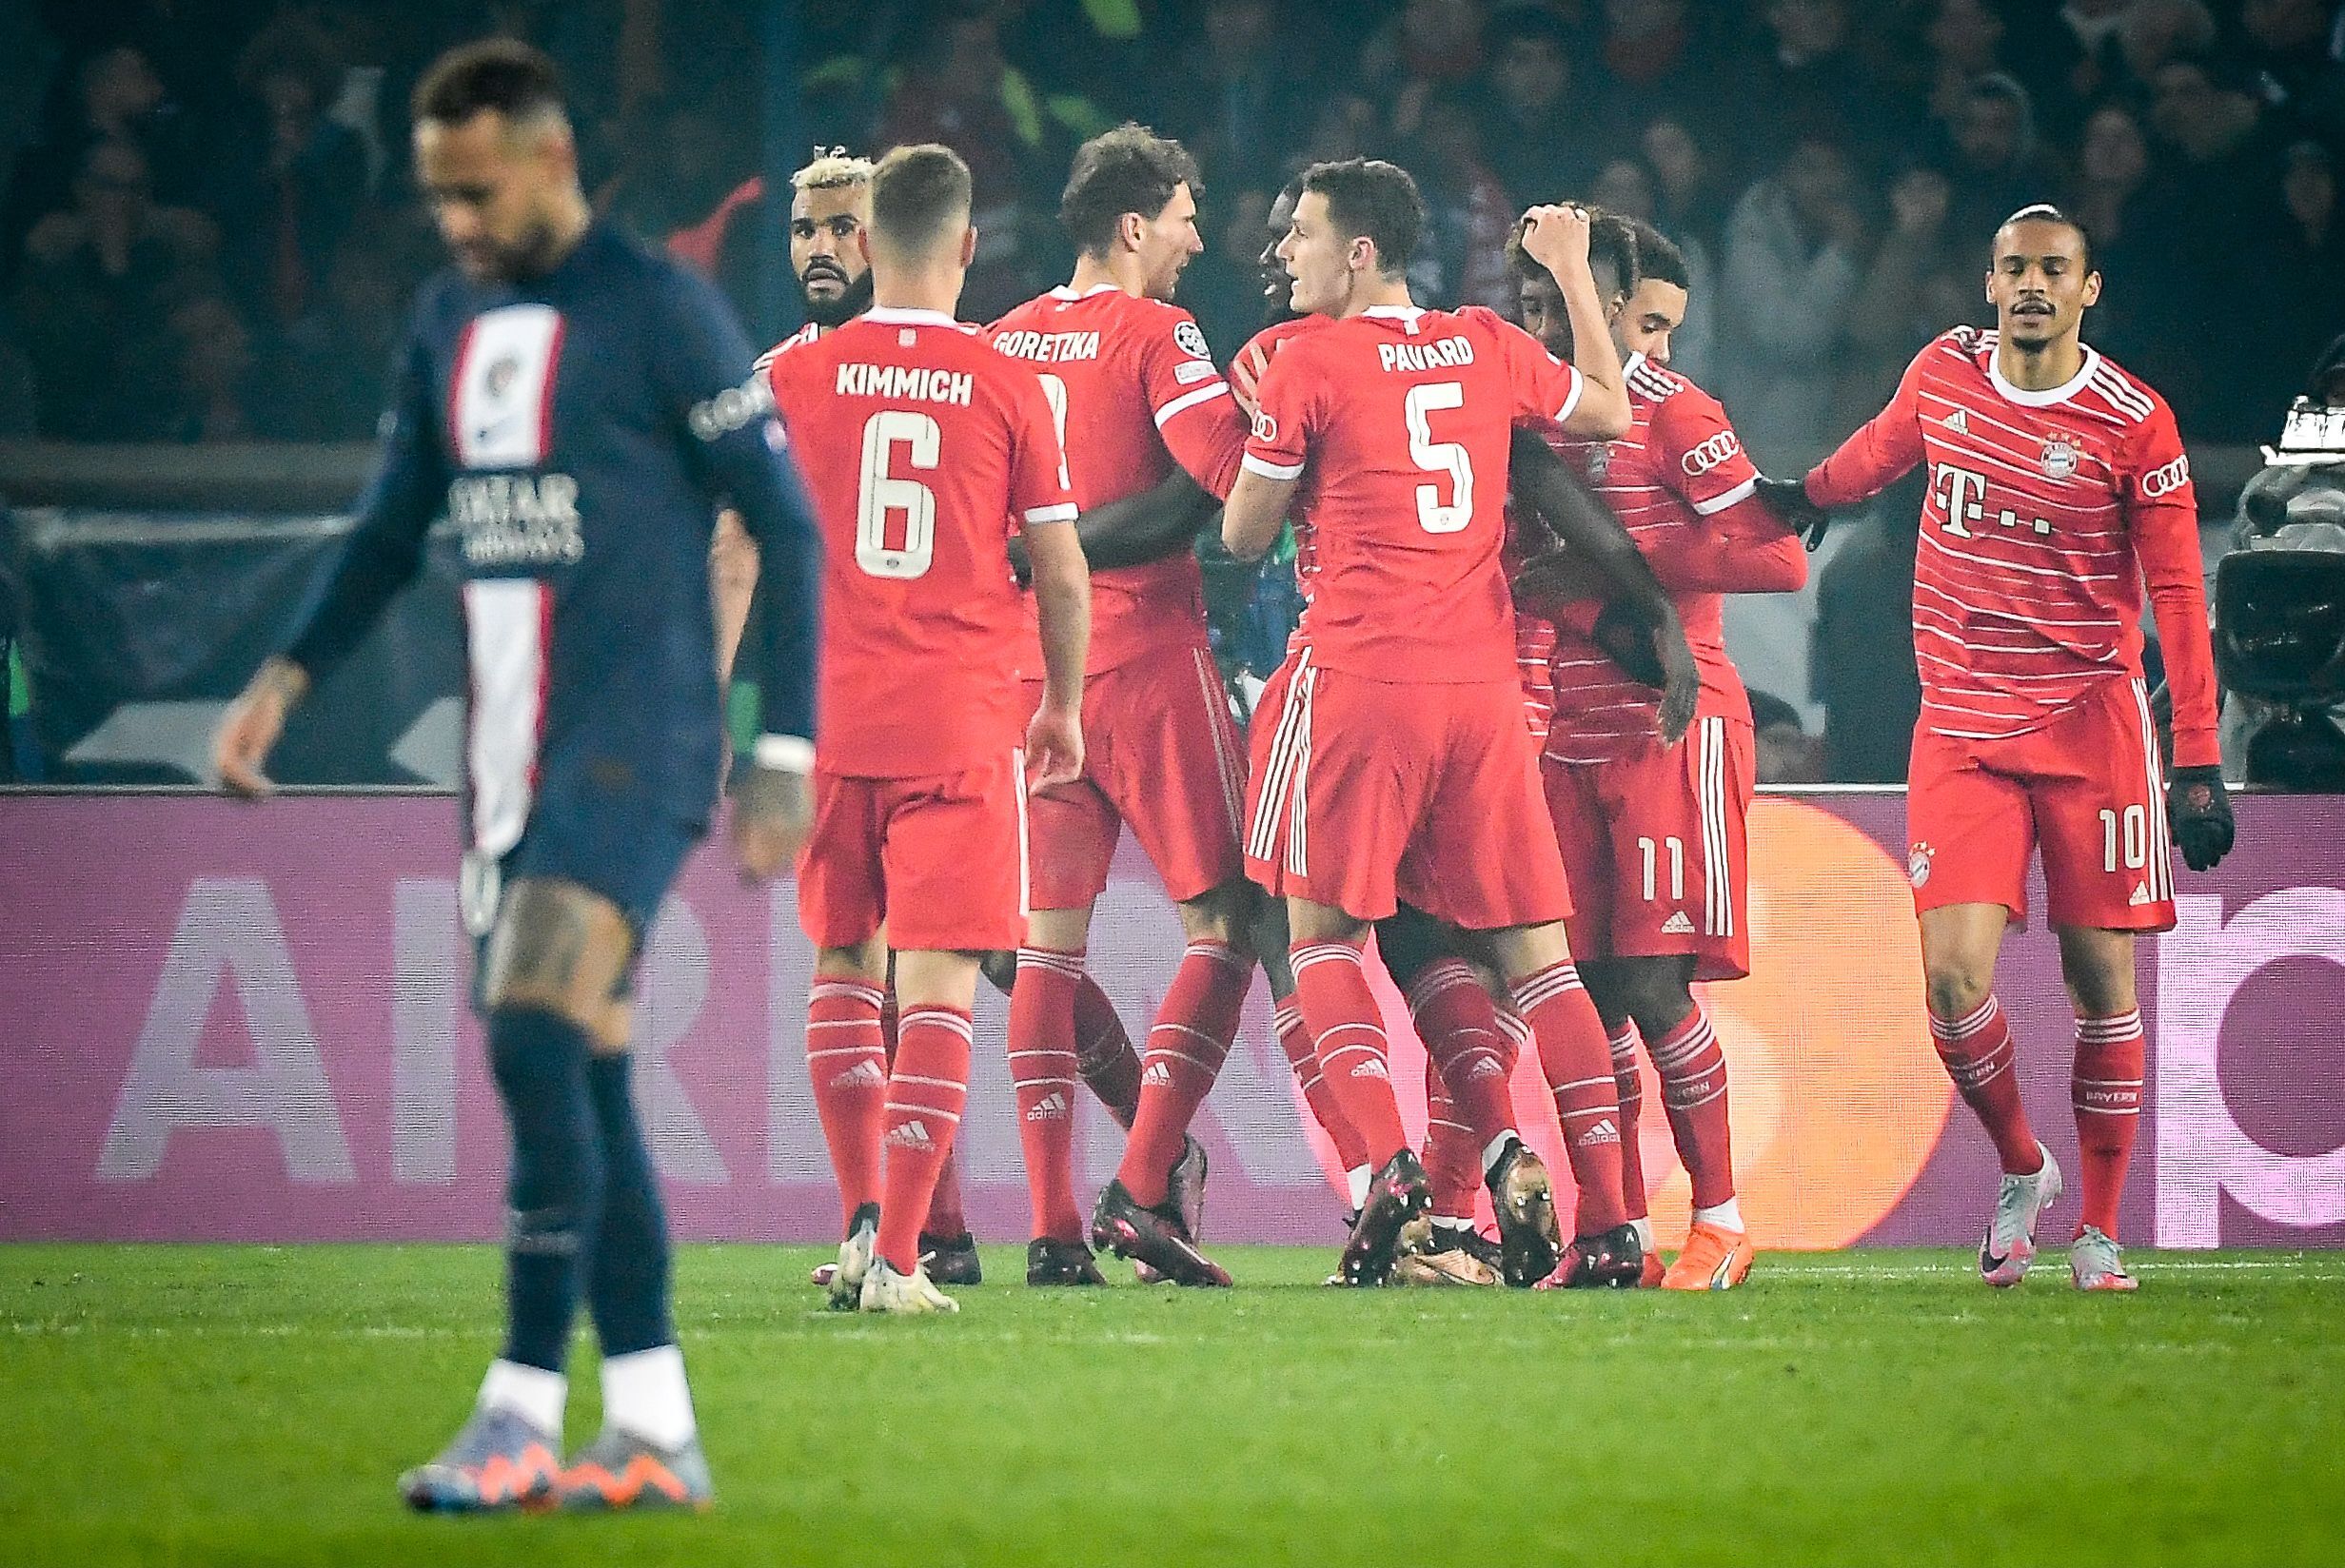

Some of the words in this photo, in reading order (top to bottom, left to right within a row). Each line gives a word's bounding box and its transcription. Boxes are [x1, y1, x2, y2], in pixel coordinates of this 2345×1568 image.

[993, 330, 1100, 363] GORETZKA
[1377, 335, 1475, 372] PAVARD
[836, 363, 974, 407] KIMMICH
[1404, 381, 1475, 535] 5
[855, 410, 942, 580] 6
[1637, 835, 1685, 902] 11
[2099, 803, 2146, 872] 10
